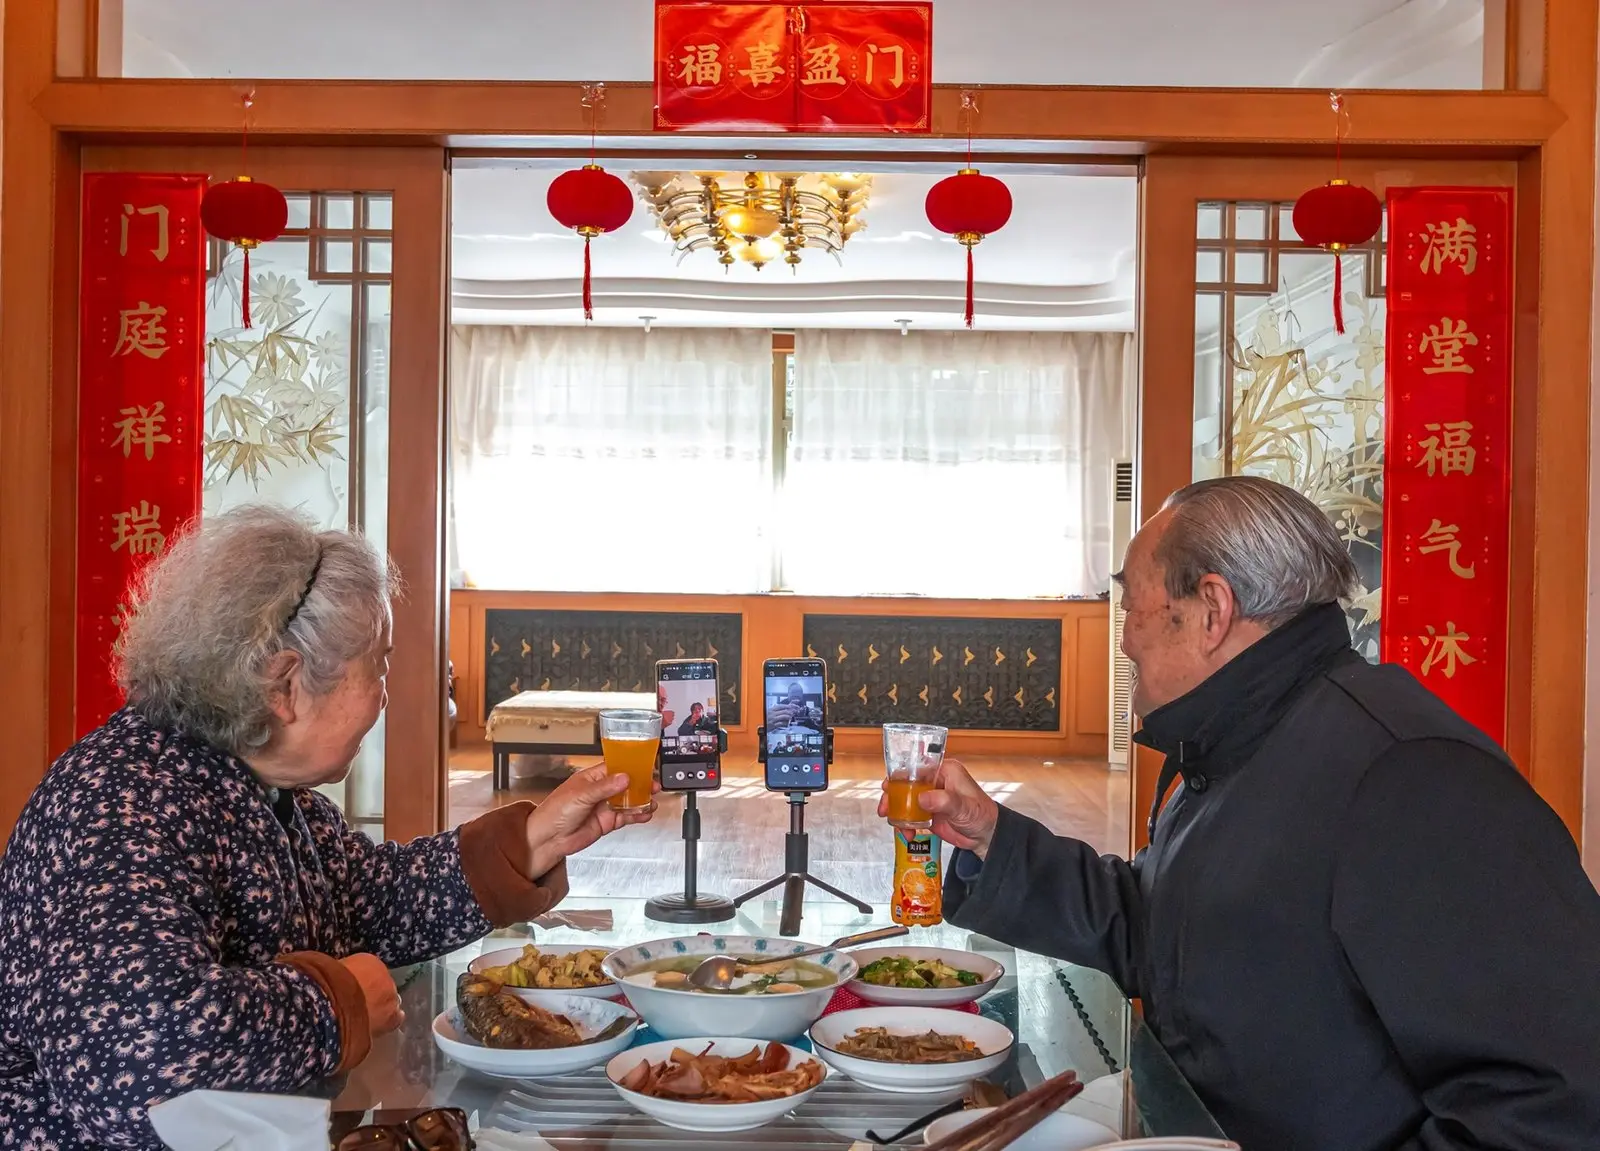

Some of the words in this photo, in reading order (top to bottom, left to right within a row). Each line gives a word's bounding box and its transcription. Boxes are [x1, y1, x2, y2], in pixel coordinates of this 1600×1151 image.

[676, 40, 905, 89] 福喜盈门
[110, 203, 173, 656] 门庭祥瑞
[1415, 216, 1480, 679] 满堂福气沐
